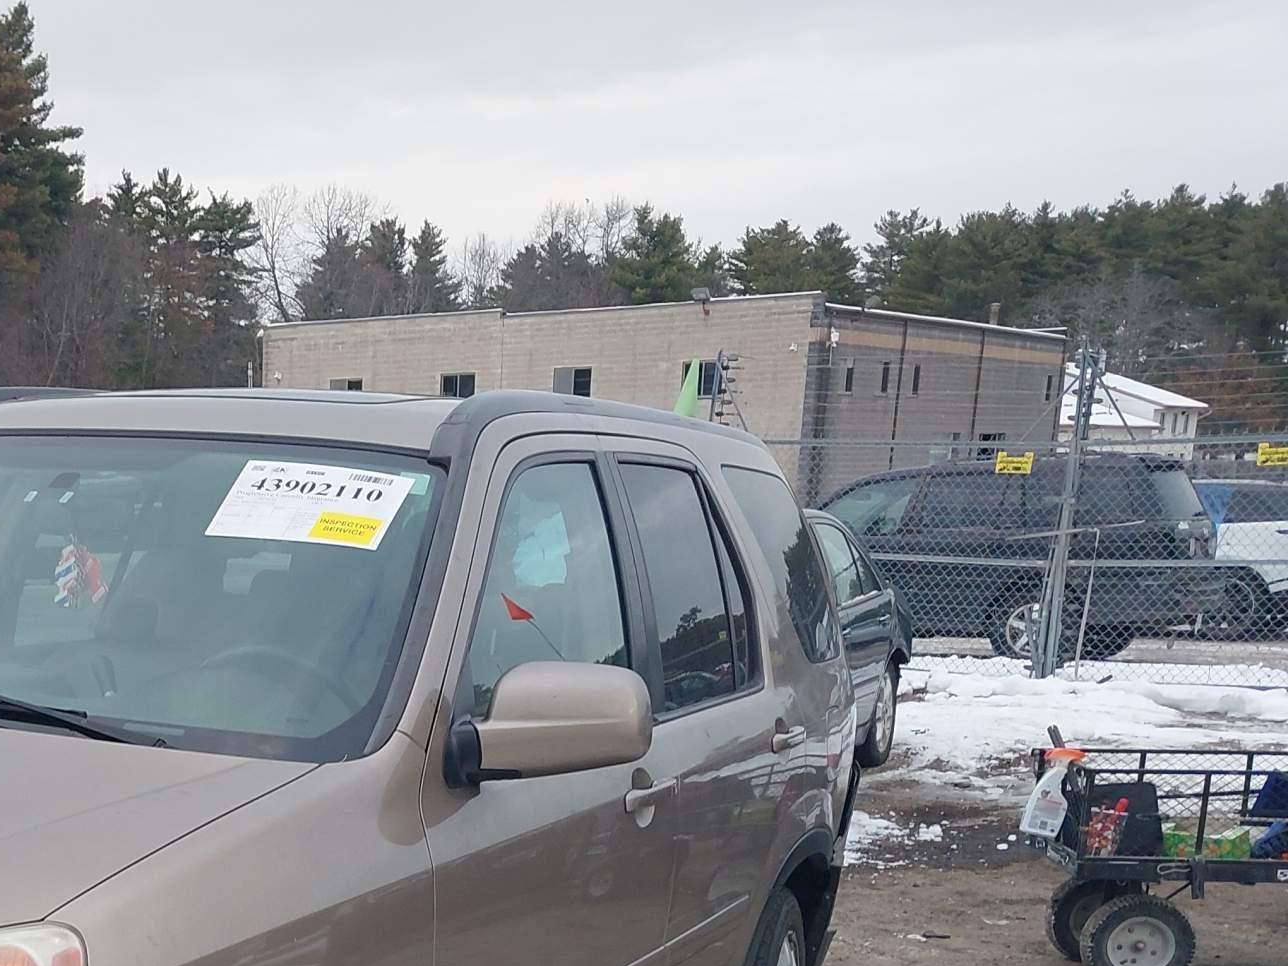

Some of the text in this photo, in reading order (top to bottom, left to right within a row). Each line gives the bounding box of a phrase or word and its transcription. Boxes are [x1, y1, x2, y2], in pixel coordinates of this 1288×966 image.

[251, 477, 384, 503] 43902110
[319, 517, 378, 531] INSPECTION
[322, 525, 366, 537] SERVICE
